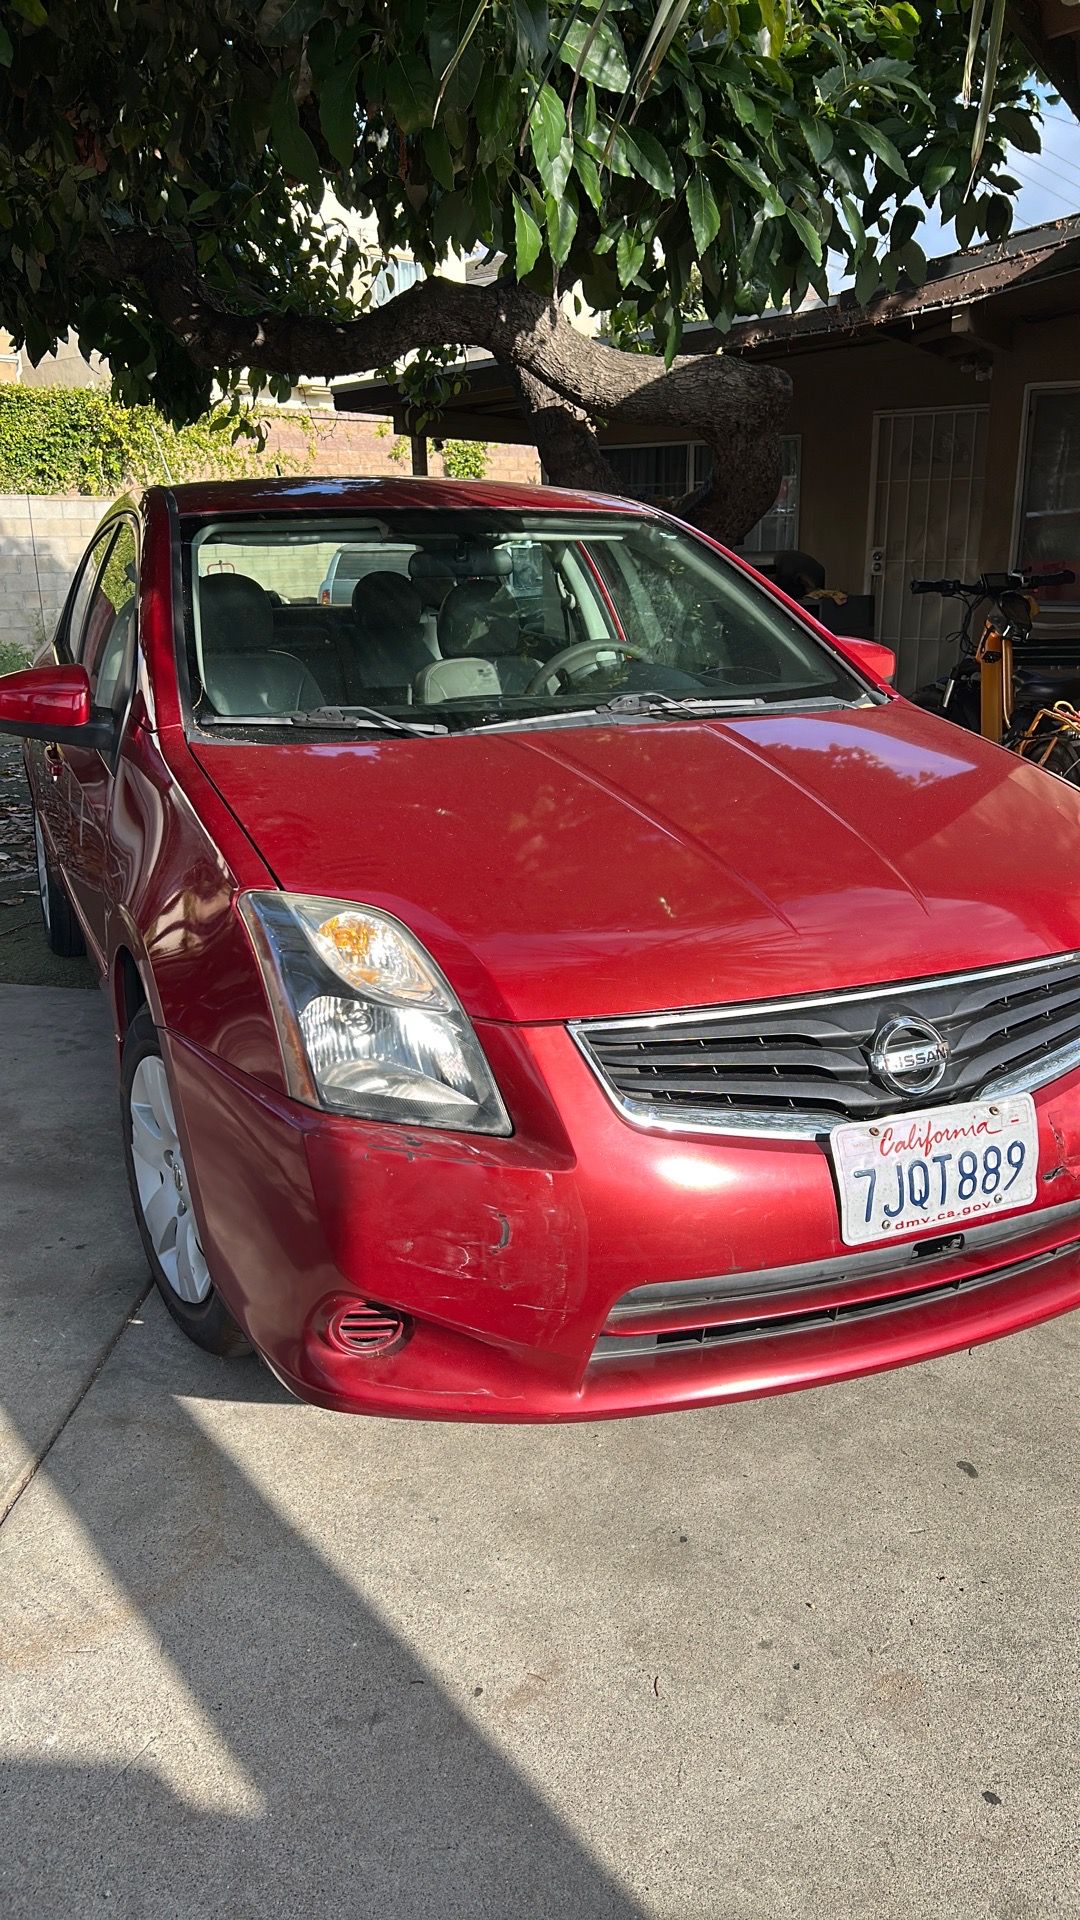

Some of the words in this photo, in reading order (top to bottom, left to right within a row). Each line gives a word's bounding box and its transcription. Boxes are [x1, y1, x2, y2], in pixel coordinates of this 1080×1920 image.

[885, 1047, 947, 1069] ISSAN
[879, 1115, 1003, 1157] California
[853, 1140, 1026, 1223] 7JQT889
[894, 1200, 992, 1230] dmv.ca.gov
